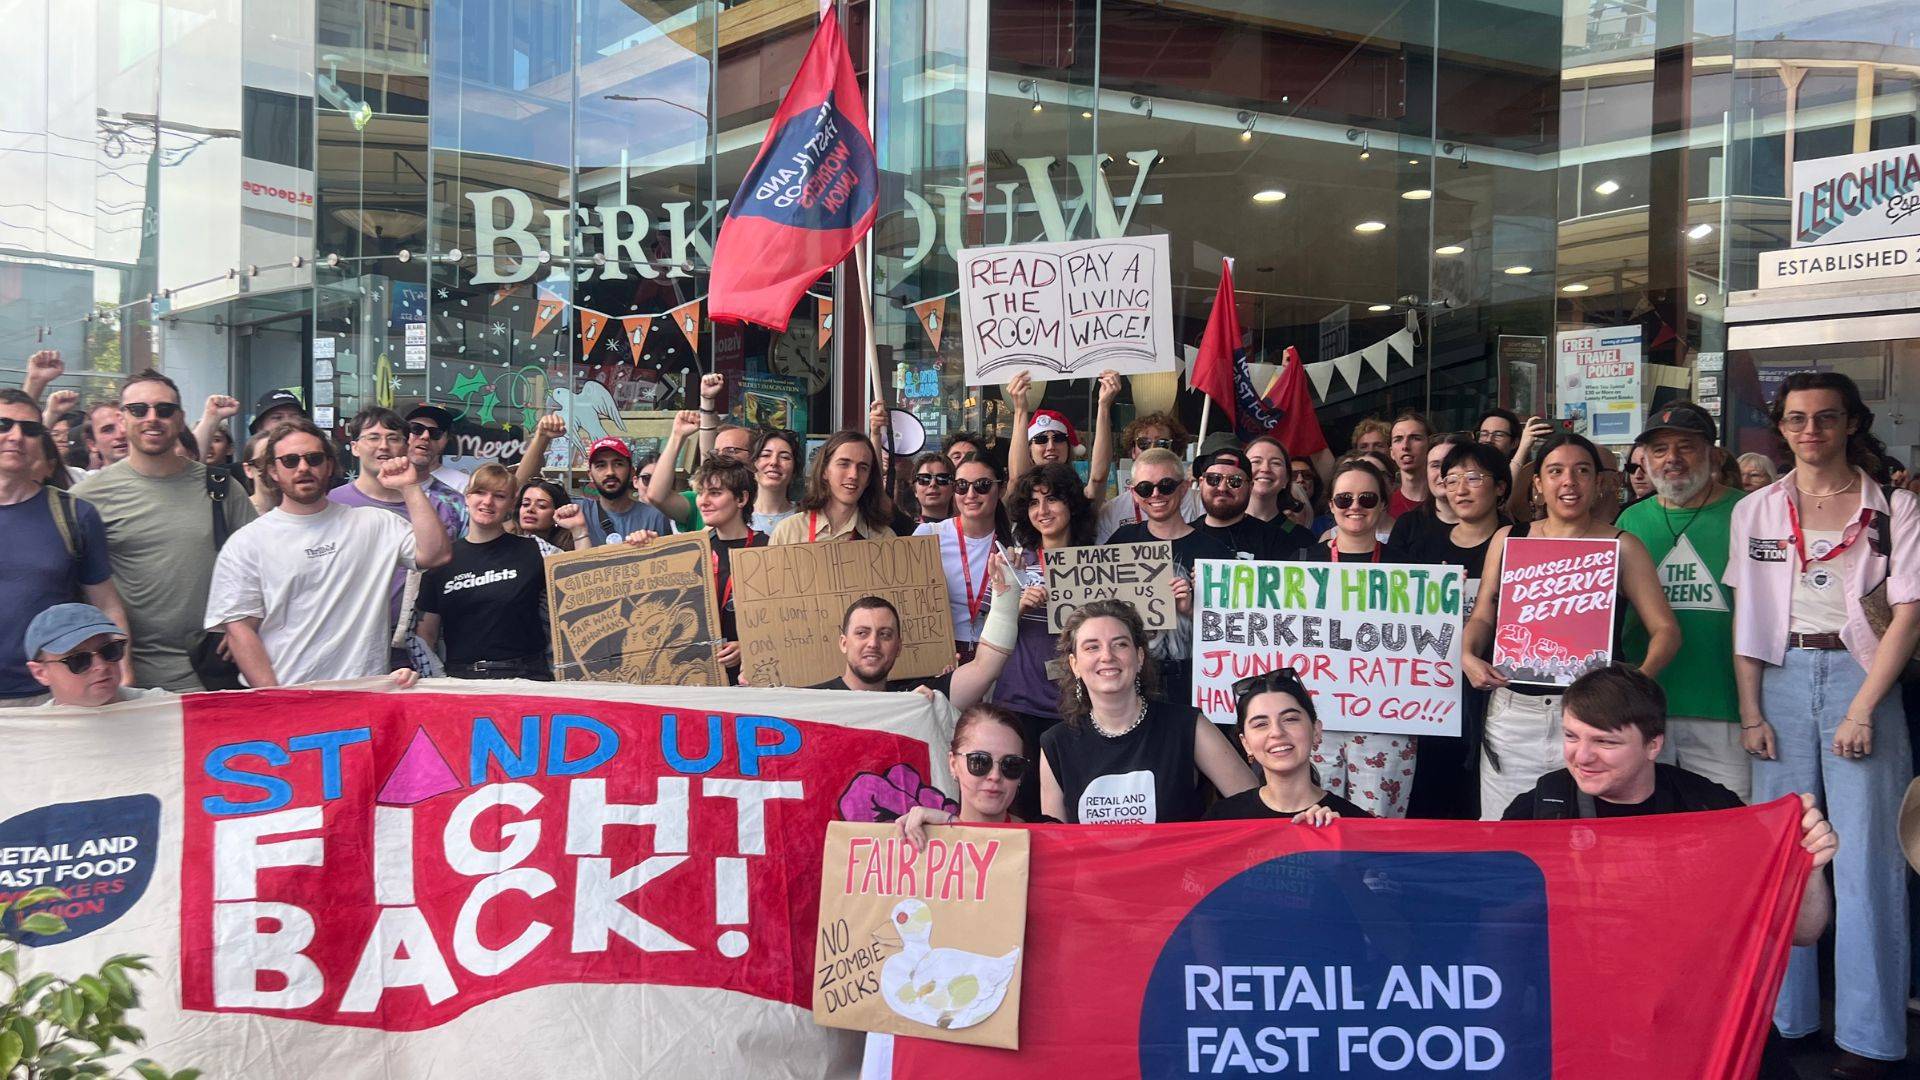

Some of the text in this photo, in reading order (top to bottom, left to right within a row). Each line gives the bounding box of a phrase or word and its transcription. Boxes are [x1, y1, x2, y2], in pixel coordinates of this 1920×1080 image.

[971, 257, 1057, 288] READ
[1067, 251, 1139, 287] PAY A
[1778, 249, 1907, 276] ESTABLISHED
[983, 290, 1040, 316] THE
[1068, 289, 1149, 315] LIVING
[976, 316, 1060, 355] ROOM
[1069, 313, 1150, 347] WAGE!
[1564, 338, 1591, 351] FREE
[1578, 350, 1620, 364] TRAVEL
[739, 546, 818, 600] READ
[820, 542, 858, 592] THE
[868, 538, 937, 585] ROOM!
[1044, 544, 1171, 566] WE MAKE YOUR
[1503, 550, 1614, 584] BOOKSELLERS
[443, 569, 517, 594] Socialists
[564, 559, 668, 591] GIRAFFES IN
[1049, 562, 1168, 588] MONEY
[1202, 564, 1330, 610] HARRY
[1512, 567, 1614, 603] DESERVE
[1666, 563, 1697, 582] THE
[566, 581, 632, 609] SUPPORT
[779, 598, 808, 623] want
[815, 598, 829, 620] to
[914, 586, 945, 615] PAGE
[1051, 586, 1154, 601] SO PAY US
[1518, 590, 1614, 623] BETTER!
[1664, 584, 1712, 603] REENS
[571, 607, 618, 637] FAIR WAGE
[749, 632, 775, 656] and
[784, 626, 815, 648] start
[823, 635, 830, 643] a
[902, 614, 944, 642] APTER!
[1201, 610, 1455, 659] BERKELOUW
[1348, 657, 1456, 688] RATES
[1197, 685, 1456, 724] HAV TO GO!!!
[661, 714, 802, 776] UP
[1086, 794, 1146, 806] RETAIL AND
[1086, 806, 1147, 819] FAST FOOD
[76, 836, 139, 858] AND
[213, 777, 804, 905] FIGHT
[54, 857, 137, 882] FOOD
[846, 836, 1000, 903] FAIR PAY
[213, 856, 750, 1013] BACK!
[821, 919, 850, 961] NO
[819, 940, 886, 991] ZOMBIE
[825, 970, 880, 1014] DUCKS
[1184, 965, 1502, 1012] RETAIL AND
[1187, 1025, 1505, 1074] FAST FOOD
